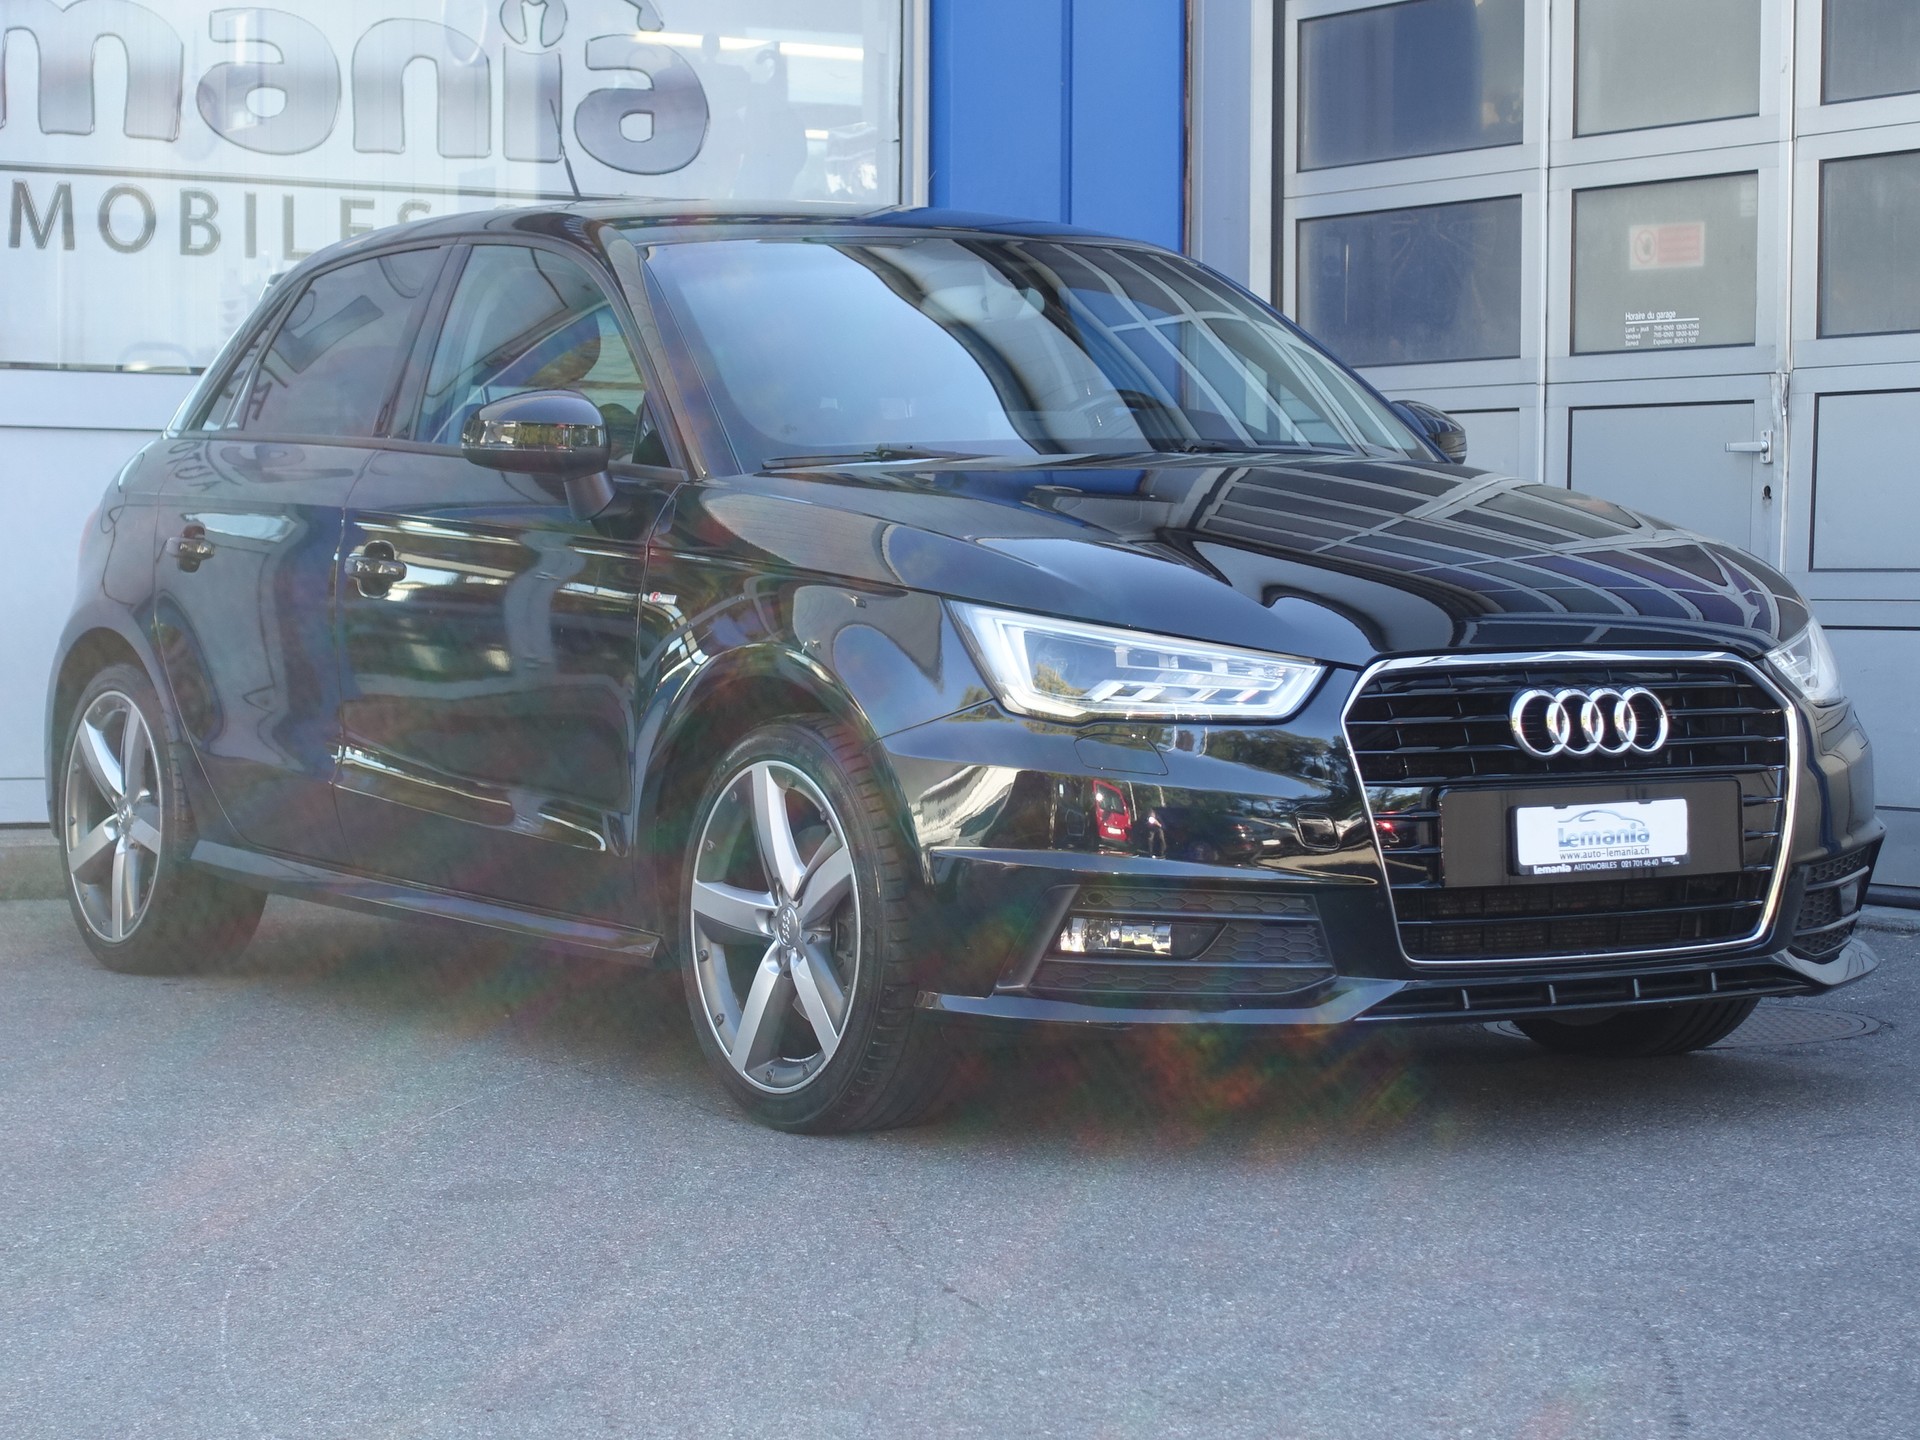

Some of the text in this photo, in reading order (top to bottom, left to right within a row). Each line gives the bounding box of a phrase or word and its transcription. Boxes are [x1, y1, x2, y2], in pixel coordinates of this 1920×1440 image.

[1625, 310, 1676, 321] Horaire du garage
[1559, 846, 1650, 860] www.auto-lemania.ch
[1574, 861, 1617, 871] AUTOMOBILES
